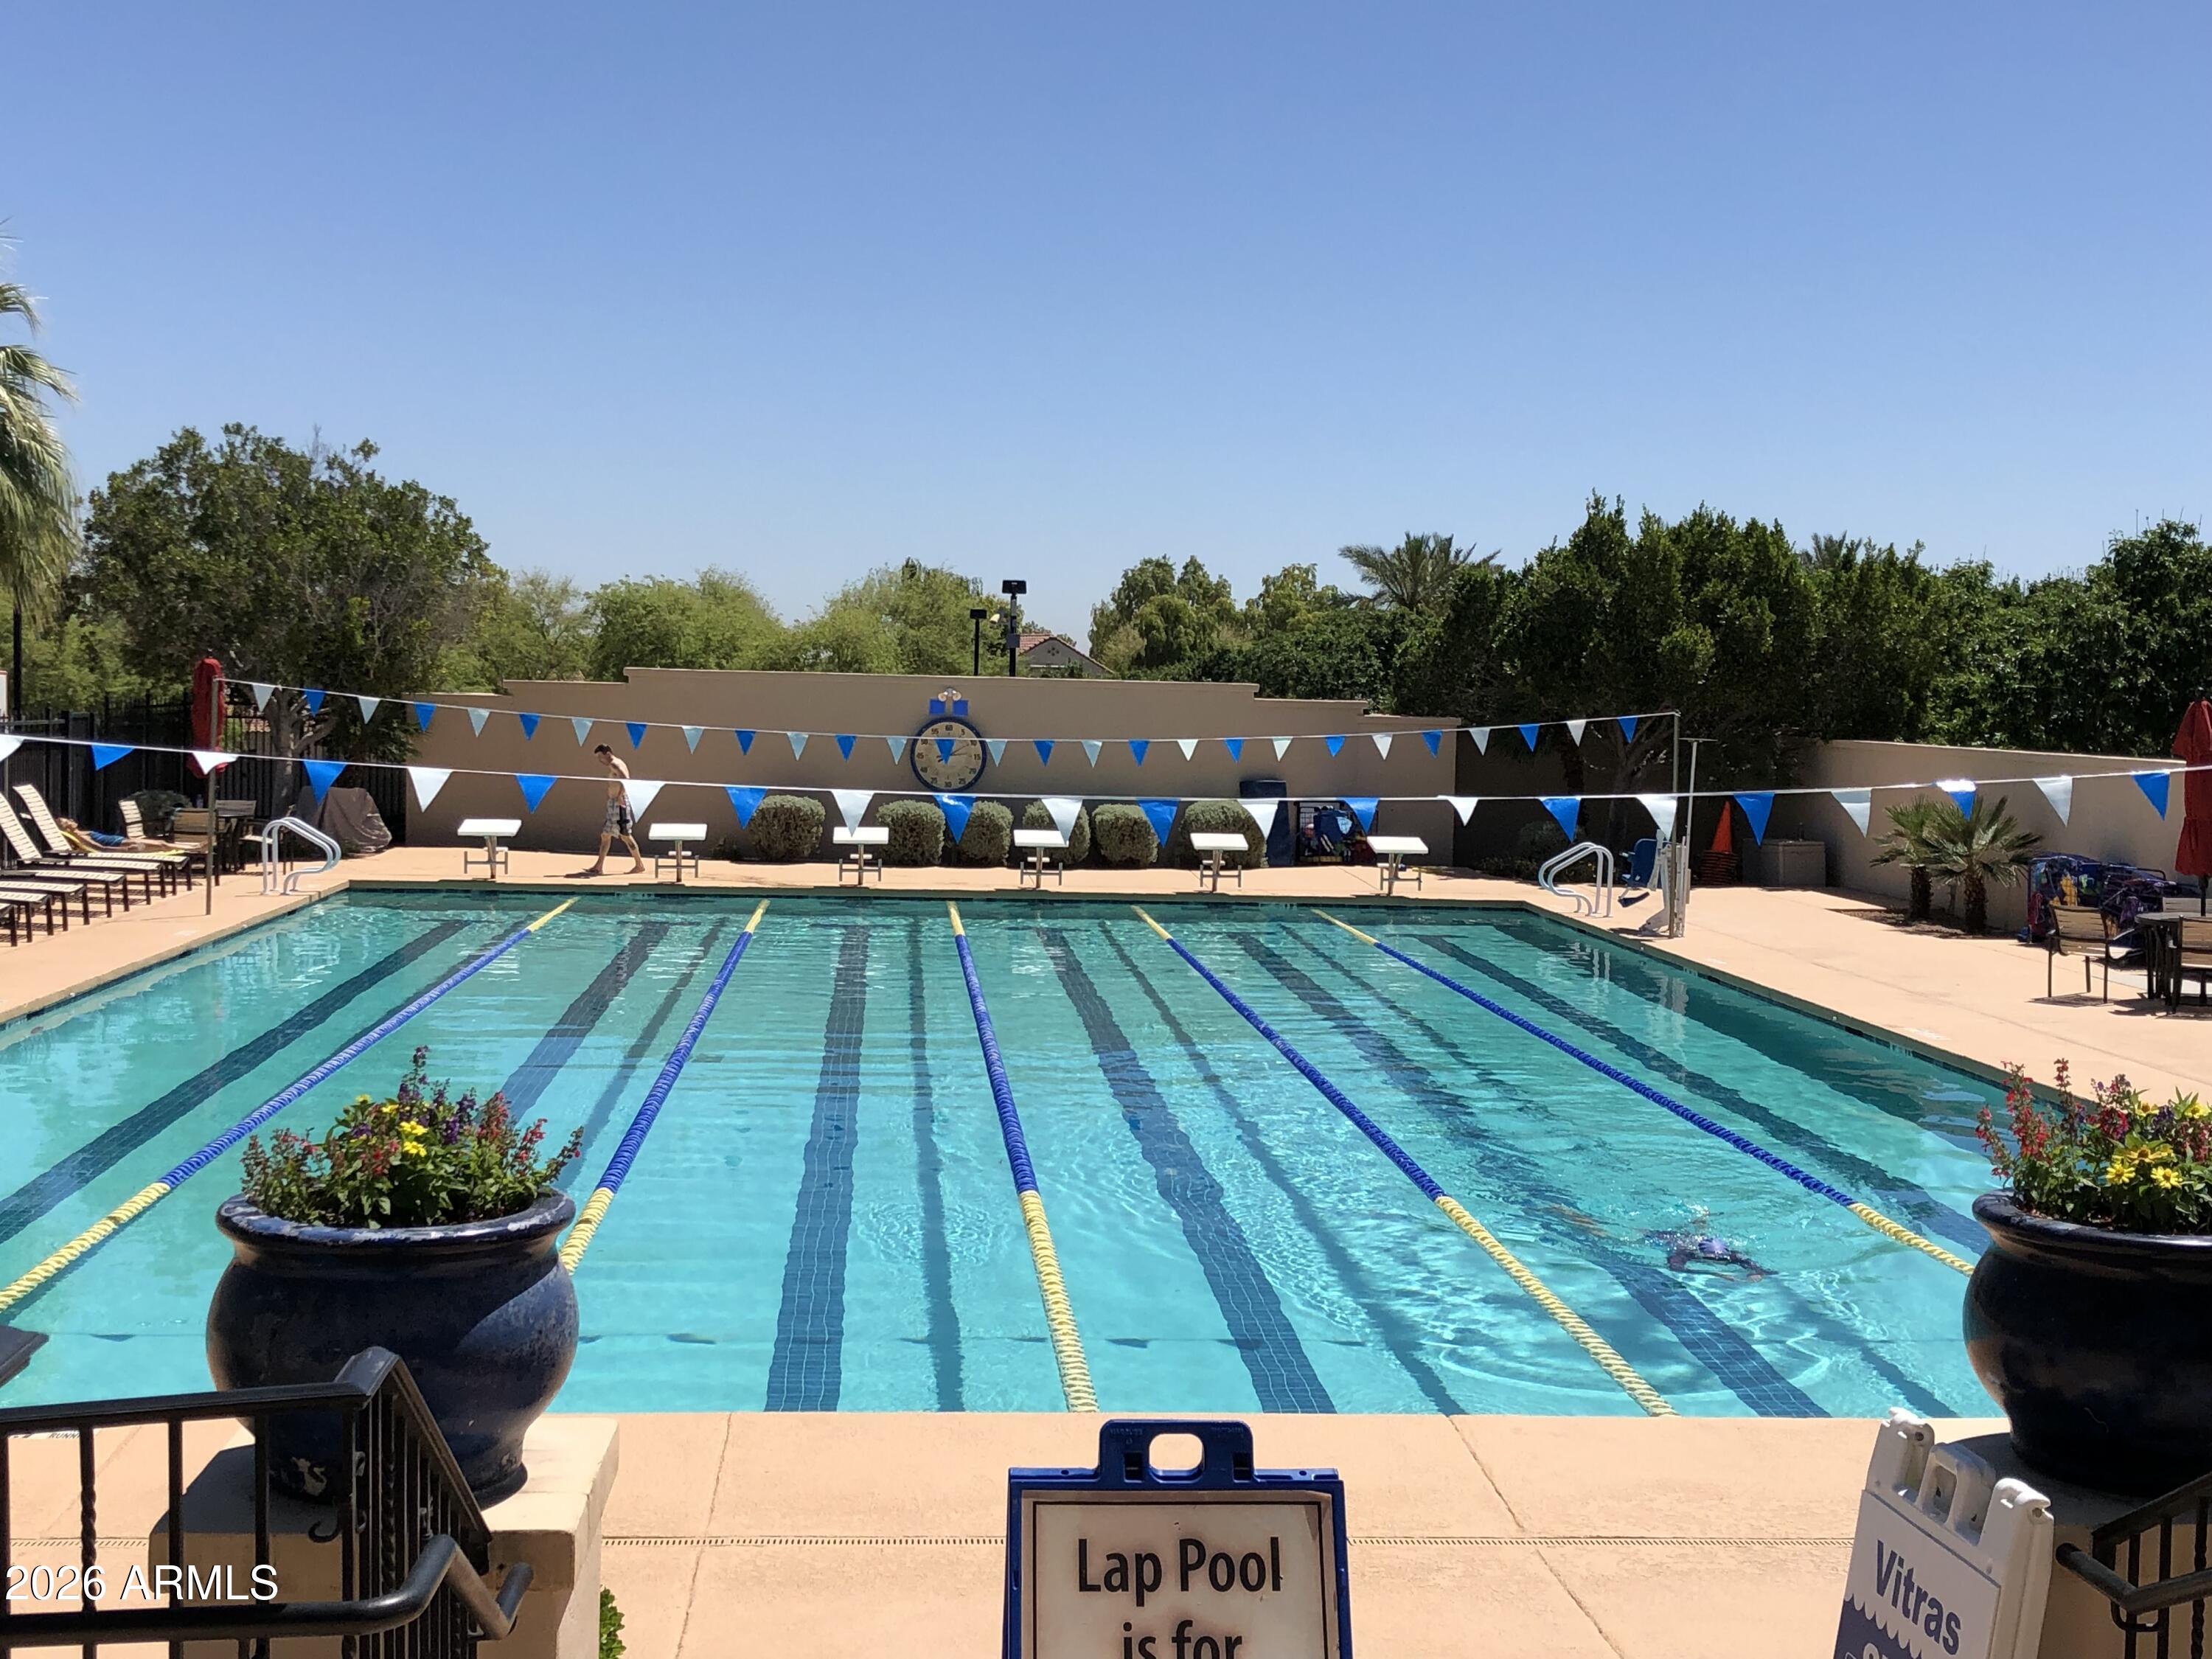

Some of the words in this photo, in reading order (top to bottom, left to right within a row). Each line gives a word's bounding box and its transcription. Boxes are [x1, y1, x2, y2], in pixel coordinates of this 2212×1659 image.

[1078, 1538, 1162, 1607] Lap
[1180, 1537, 1281, 1592] Pool
[1876, 1538, 1961, 1656] Vitras
[1123, 1621, 1157, 1659] is
[1171, 1619, 1243, 1659] for
